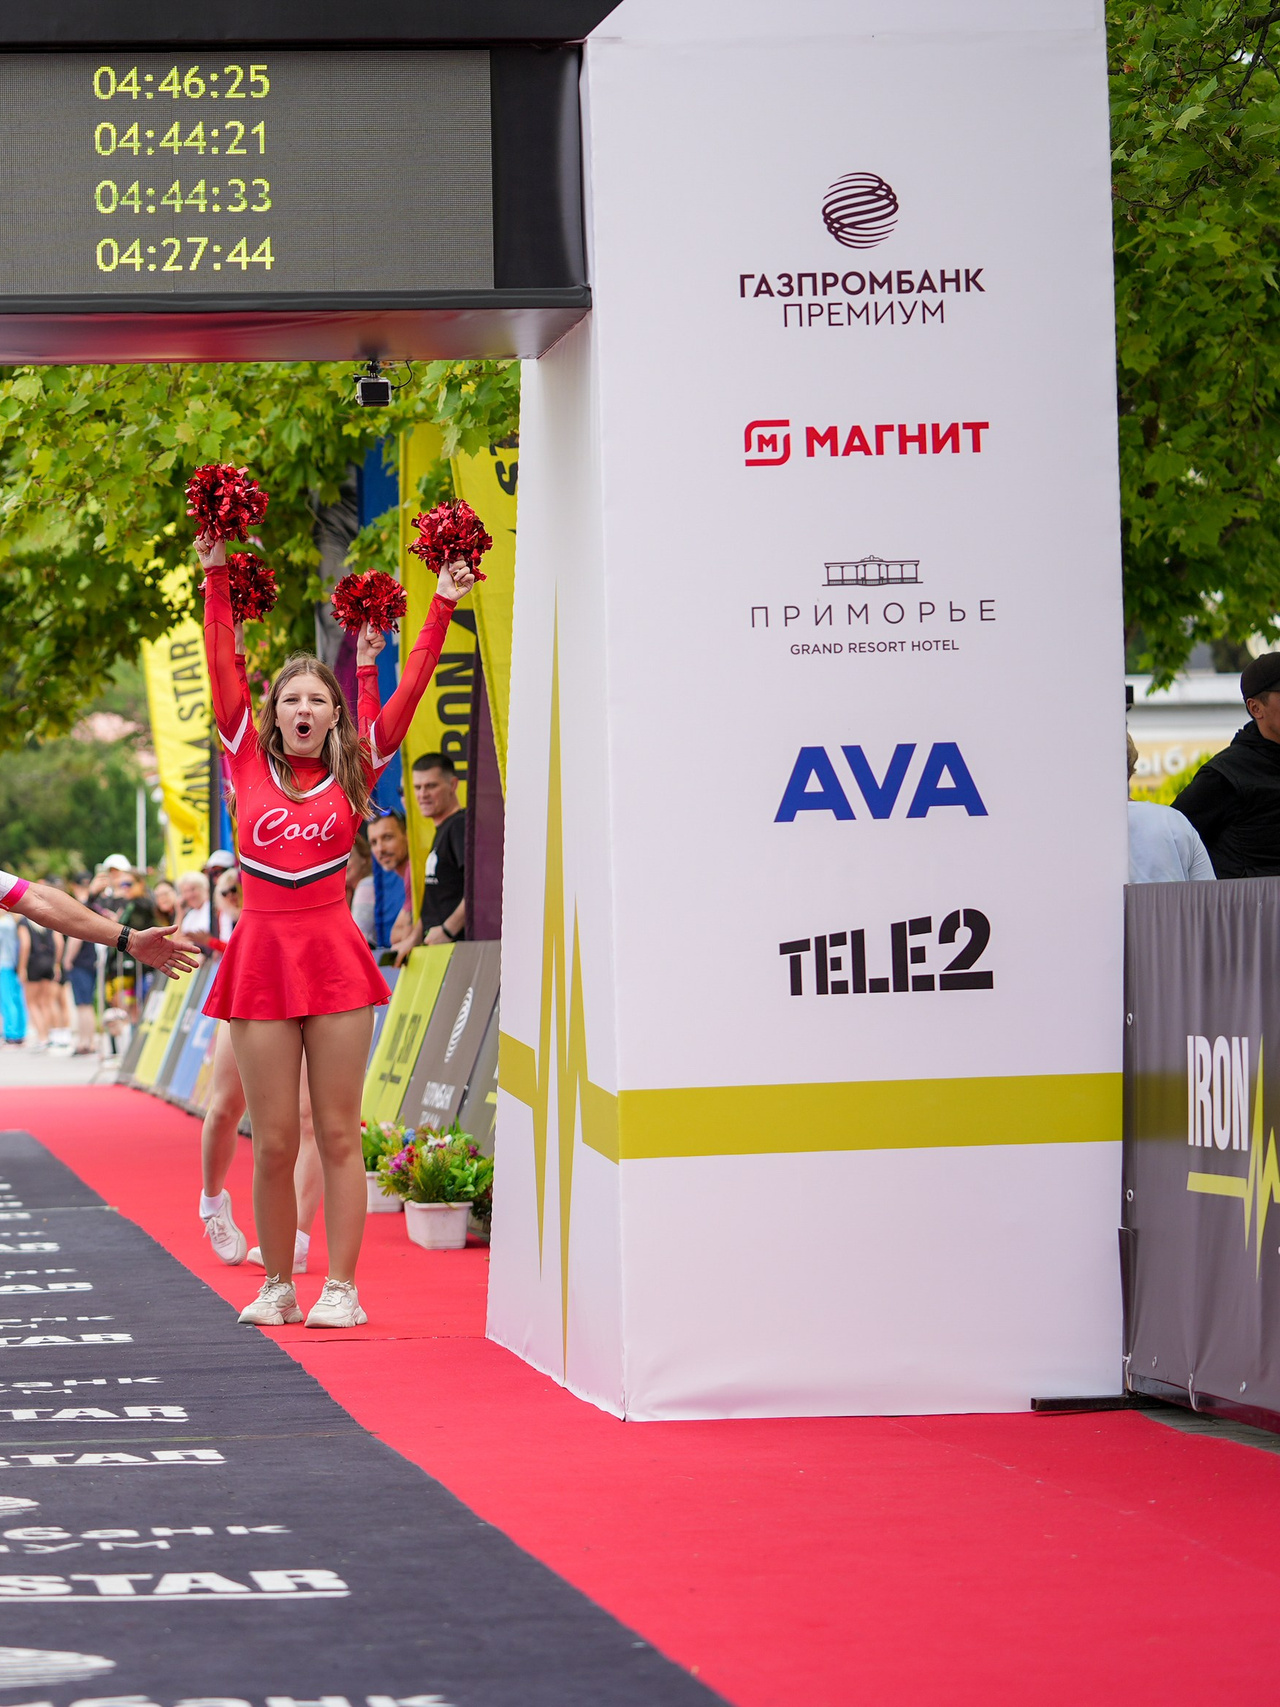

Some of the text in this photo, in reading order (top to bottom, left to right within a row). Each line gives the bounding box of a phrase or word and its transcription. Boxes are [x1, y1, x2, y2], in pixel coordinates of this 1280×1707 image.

[93, 65, 270, 99] 04:46:25
[94, 121, 267, 156] 04:44:21
[94, 178, 272, 214] 04:44:33
[96, 237, 274, 272] 04:27:44
[739, 269, 985, 298] ГАЗПРОМБАНК
[783, 300, 945, 328] ПРЕМИУМ
[806, 421, 989, 457] МАГНИТ
[751, 600, 996, 628] ПРИМОРЬЕ
[790, 640, 959, 655] GRAND RESORT HOTEL
[171, 639, 204, 722] STAR
[775, 742, 988, 823] AVA
[253, 808, 337, 846] Cool
[779, 908, 993, 996] TELE2
[1186, 1035, 1249, 1151] IRON
